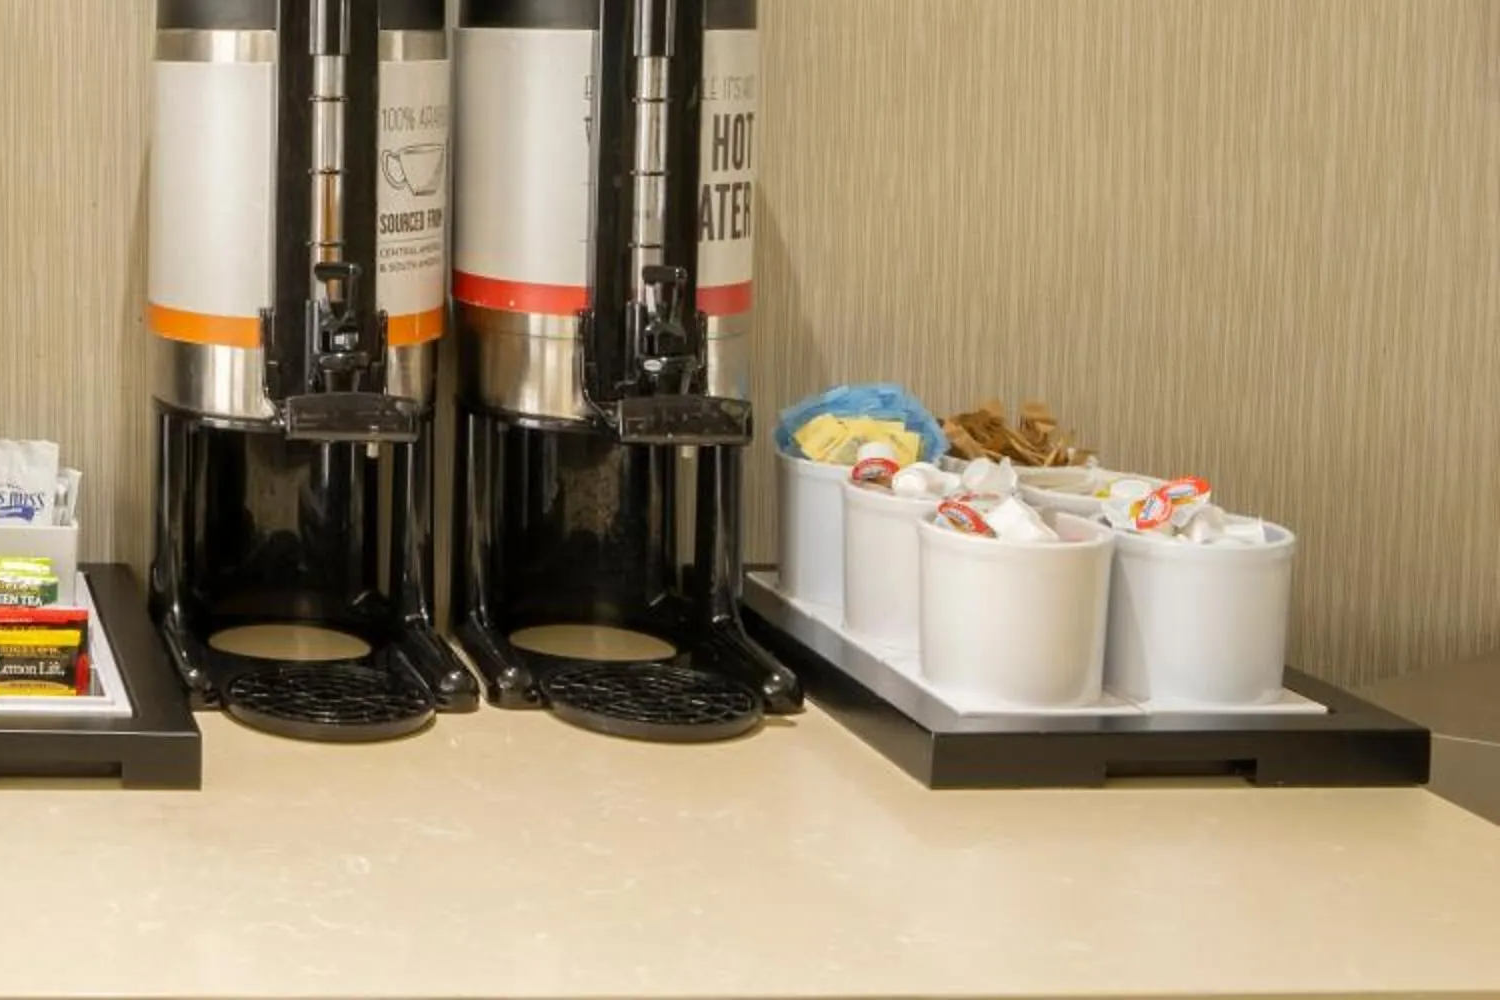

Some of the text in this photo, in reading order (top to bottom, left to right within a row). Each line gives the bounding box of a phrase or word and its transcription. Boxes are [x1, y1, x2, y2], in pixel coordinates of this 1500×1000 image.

[712, 112, 754, 171] HOT
[379, 211, 424, 234] SOURCED
[699, 182, 752, 242] ATER
